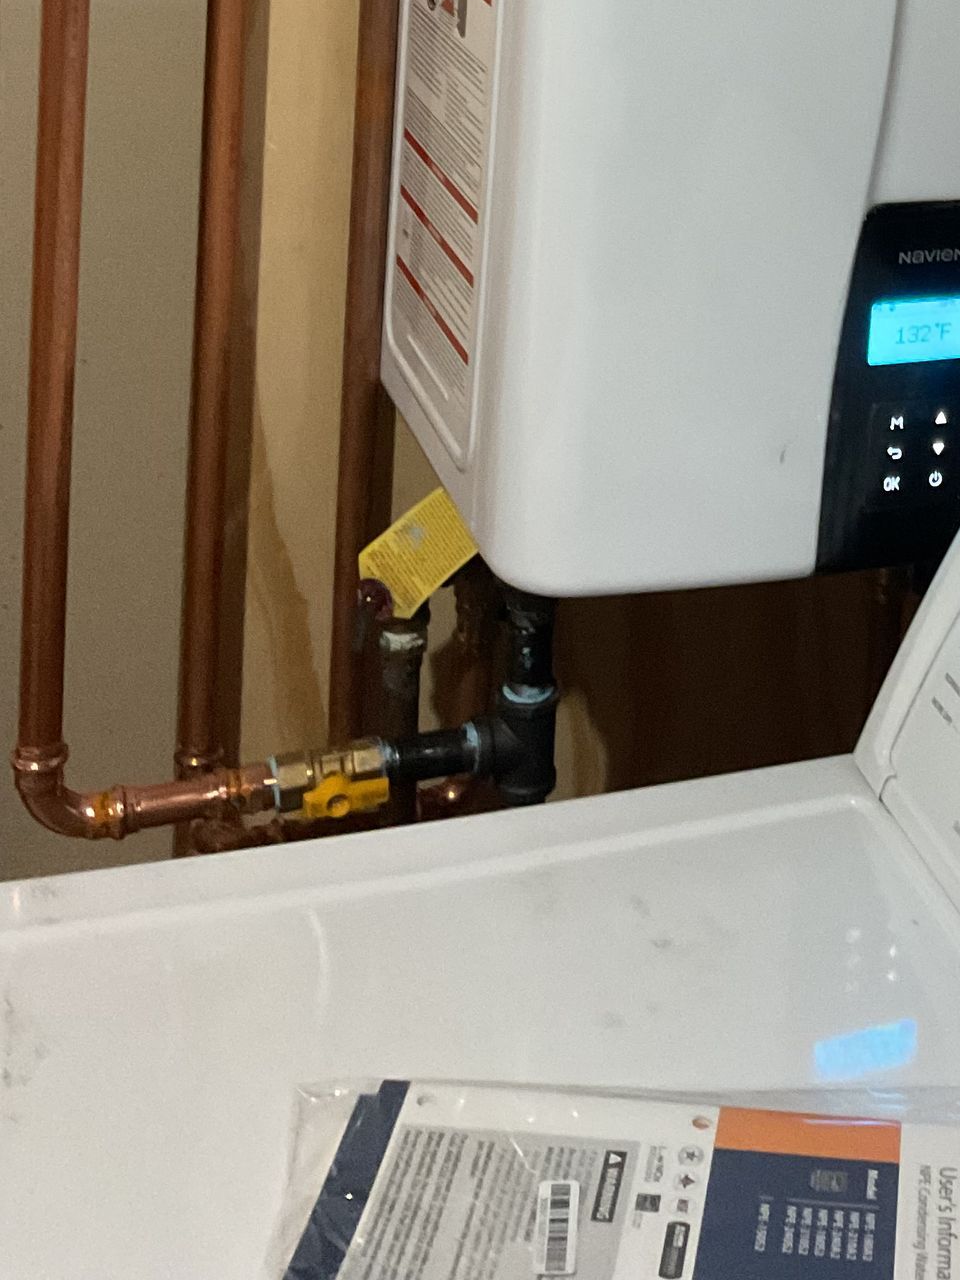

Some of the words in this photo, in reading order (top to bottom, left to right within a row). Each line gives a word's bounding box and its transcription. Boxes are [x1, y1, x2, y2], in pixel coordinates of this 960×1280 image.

[889, 415, 904, 431] M
[883, 475, 901, 493] OK
[938, 1166, 958, 1215] User's
